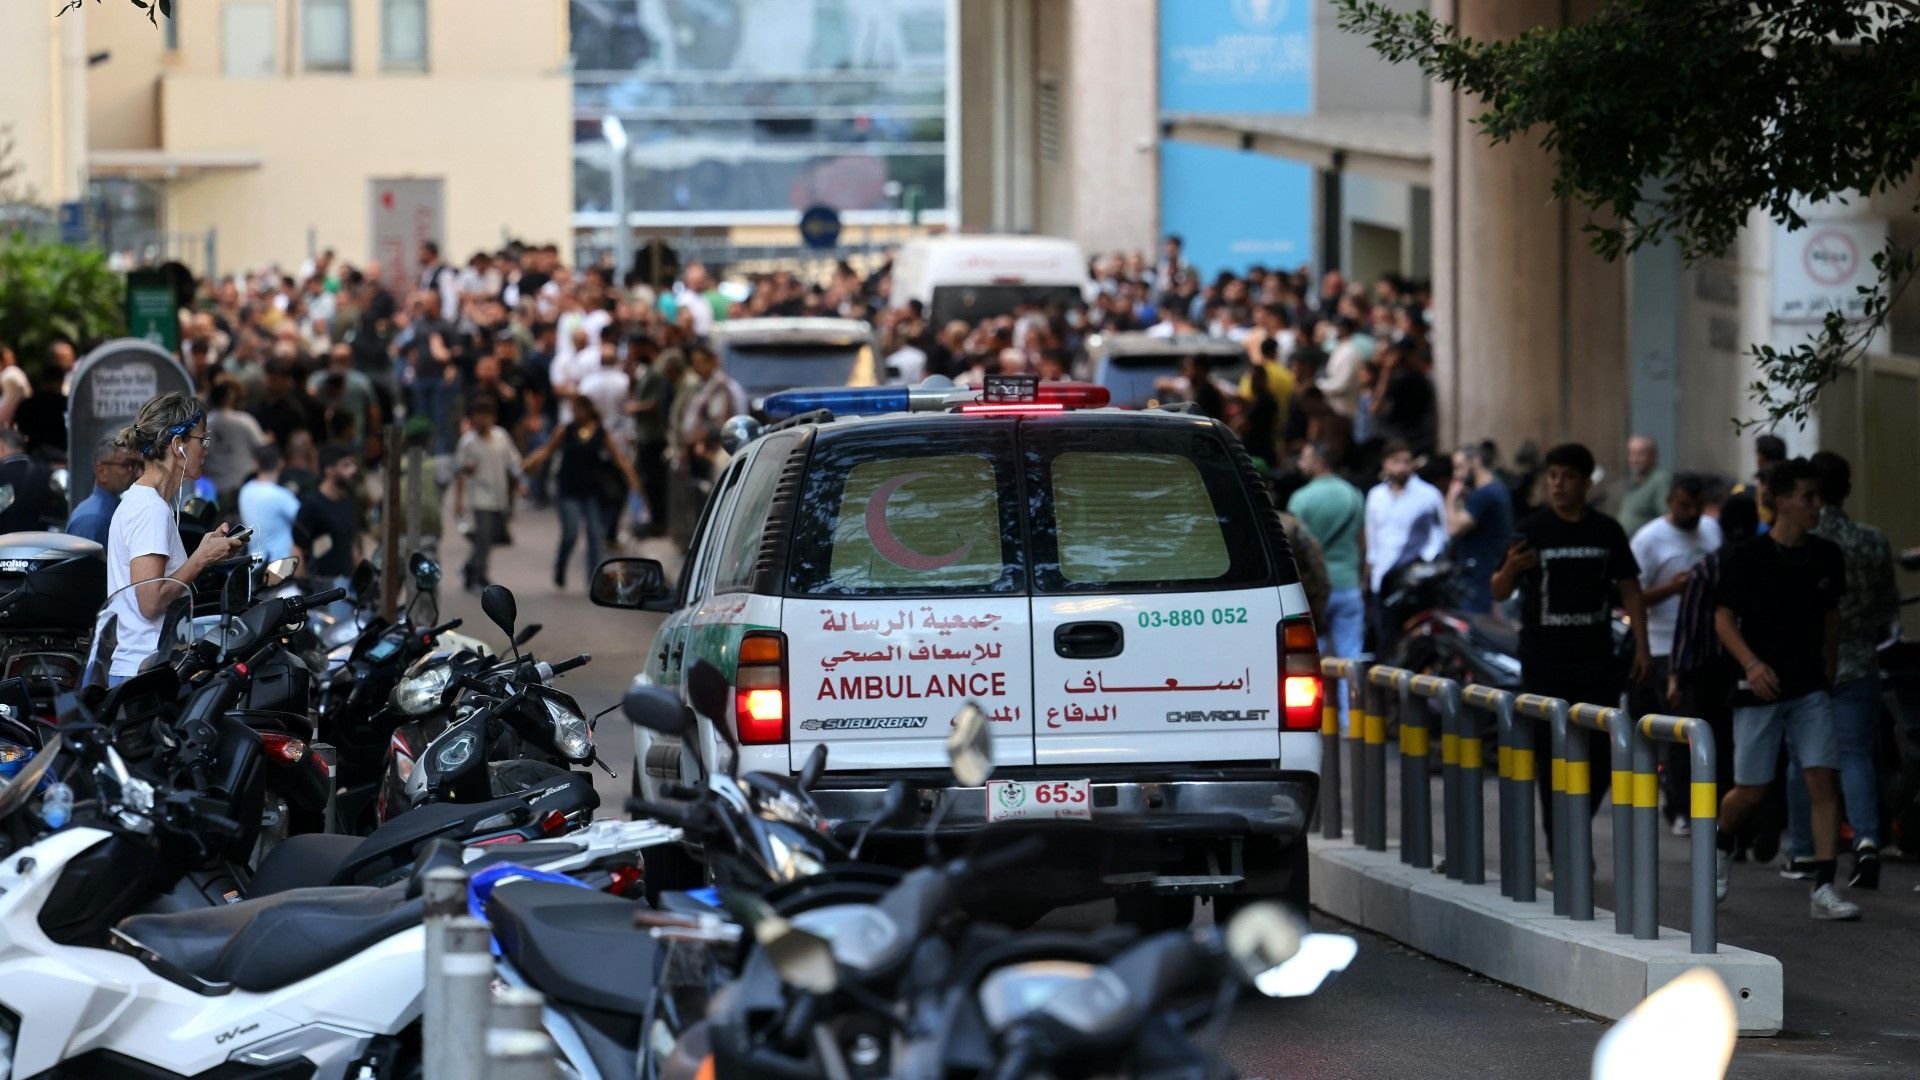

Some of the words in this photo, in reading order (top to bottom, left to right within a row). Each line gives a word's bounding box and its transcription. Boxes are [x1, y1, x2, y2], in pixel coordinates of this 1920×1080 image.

[819, 609, 914, 635] الرسالة
[920, 606, 1002, 635] جمعية
[1138, 609, 1205, 628] 03-880
[1212, 607, 1248, 625] 052
[820, 645, 902, 672] الصحي
[908, 639, 1002, 666] للإسعاف
[817, 672, 1006, 700] AMBULANCE
[821, 716, 928, 730] SUBURBAN
[950, 706, 1020, 728] المد
[1046, 703, 1118, 728] الدفاع
[1166, 709, 1270, 723] CHEVROLET
